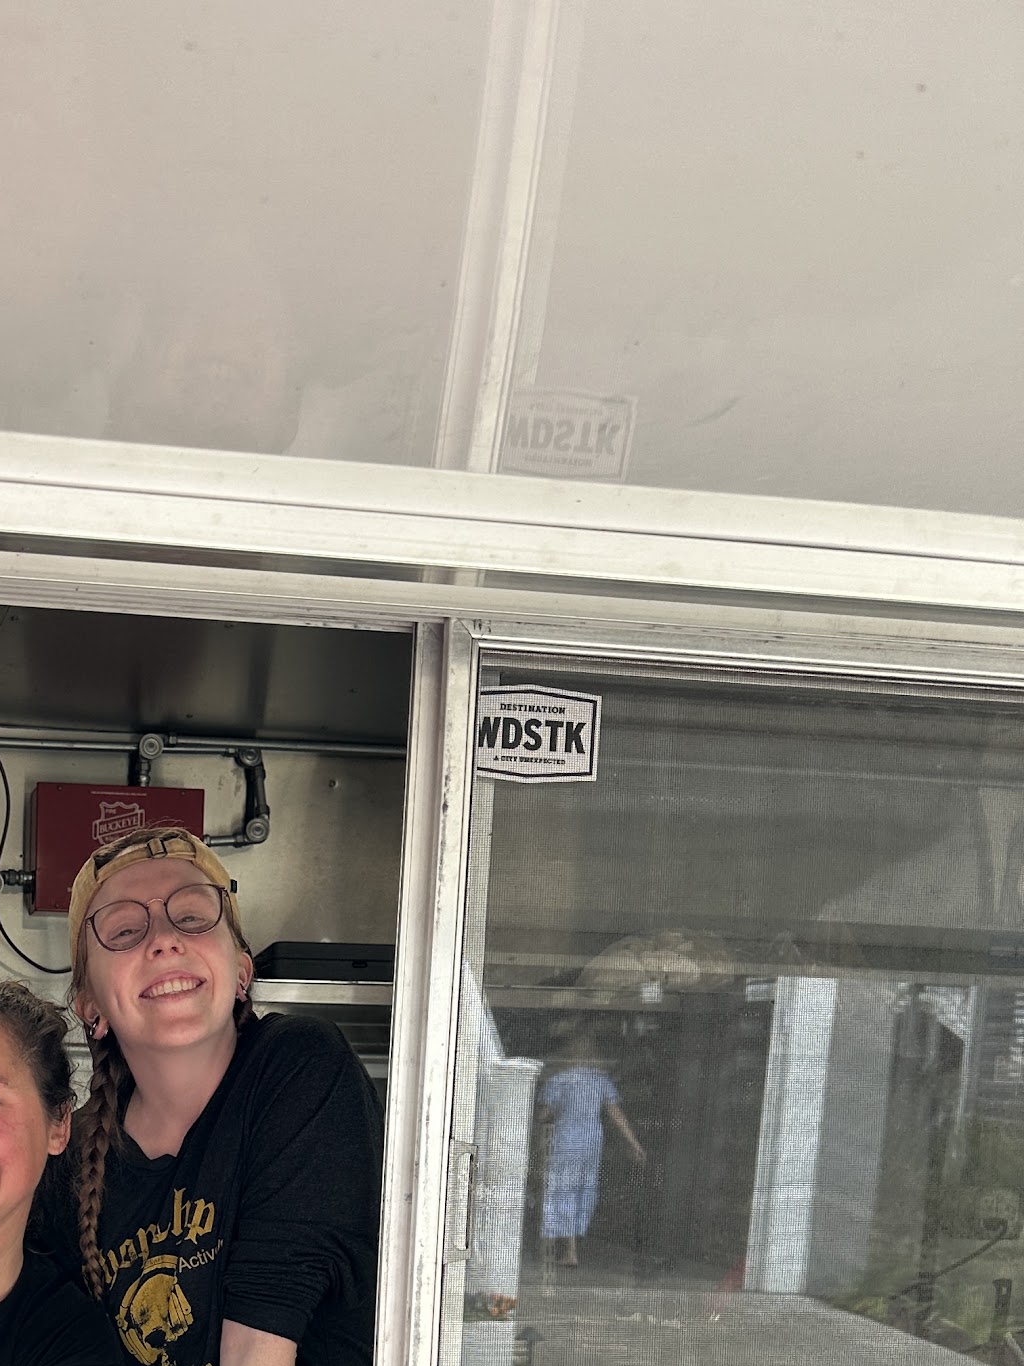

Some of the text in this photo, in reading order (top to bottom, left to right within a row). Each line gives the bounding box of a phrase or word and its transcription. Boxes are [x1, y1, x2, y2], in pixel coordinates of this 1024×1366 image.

[499, 703, 566, 715] DESTINATION
[478, 716, 587, 754] WDSTK
[519, 756, 566, 765] UNEXPECTED
[99, 816, 138, 834] BUCKEYE
